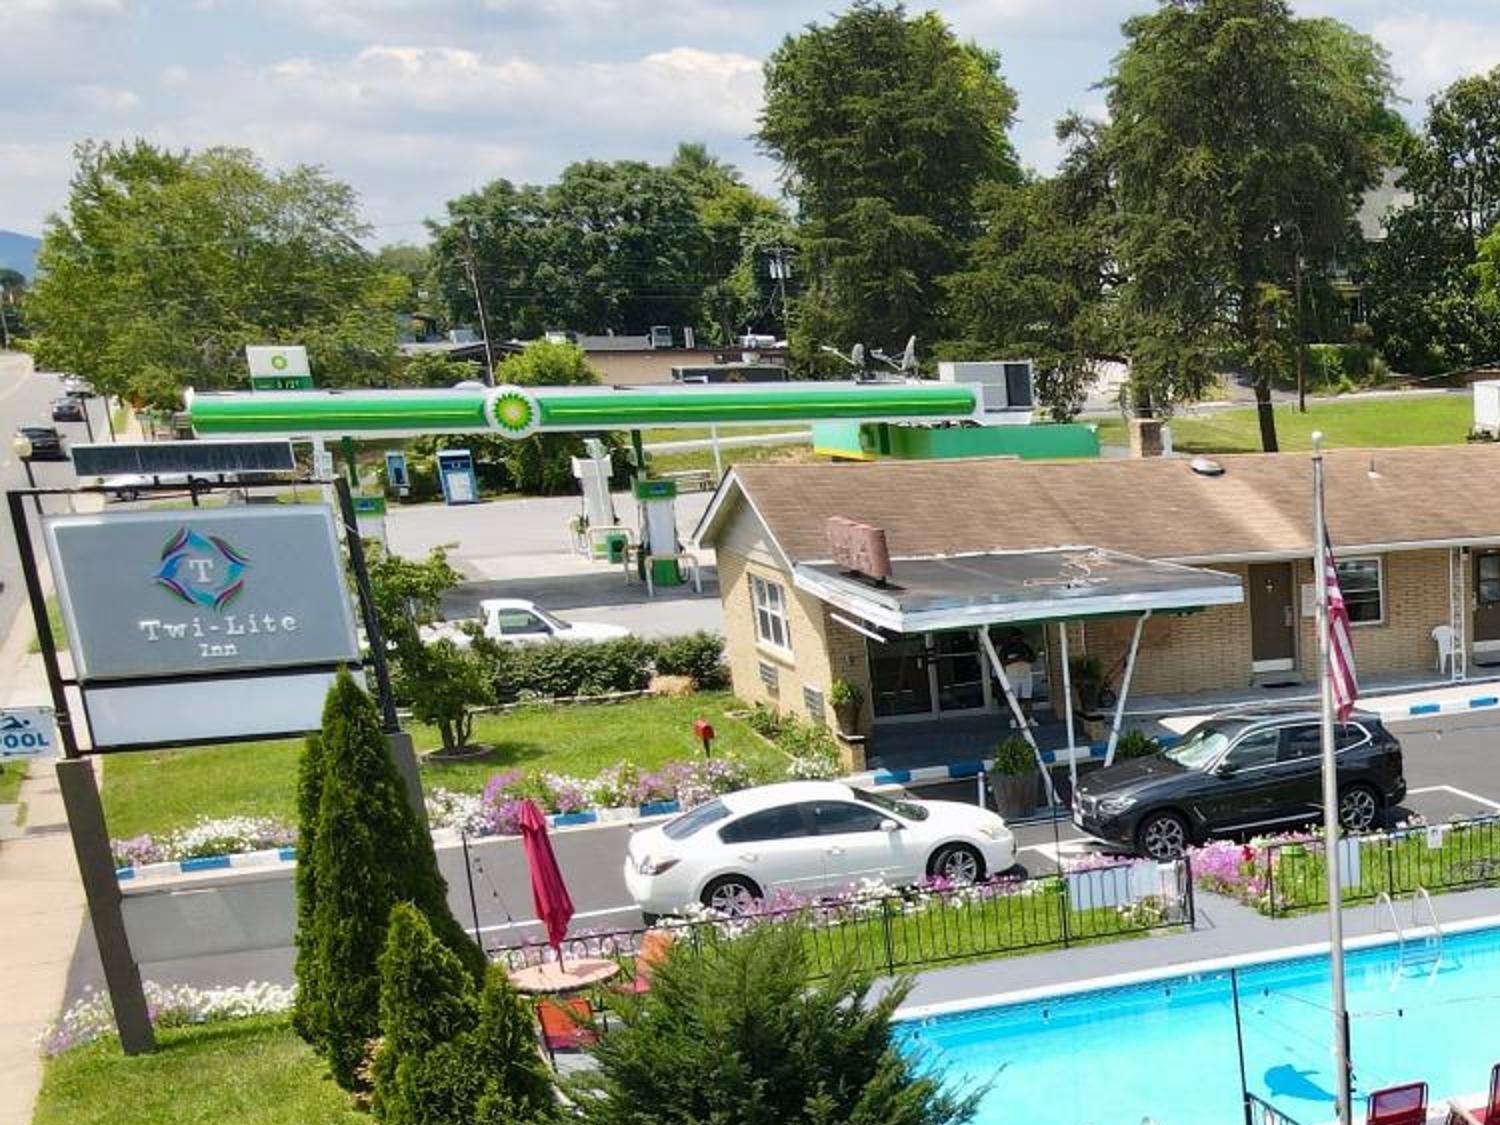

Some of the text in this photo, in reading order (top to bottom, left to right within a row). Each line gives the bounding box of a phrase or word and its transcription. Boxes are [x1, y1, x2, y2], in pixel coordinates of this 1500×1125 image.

[189, 558, 214, 584] T
[139, 613, 299, 641] Twi-Lite
[198, 642, 238, 657] Inn
[0, 732, 49, 748] OOL
